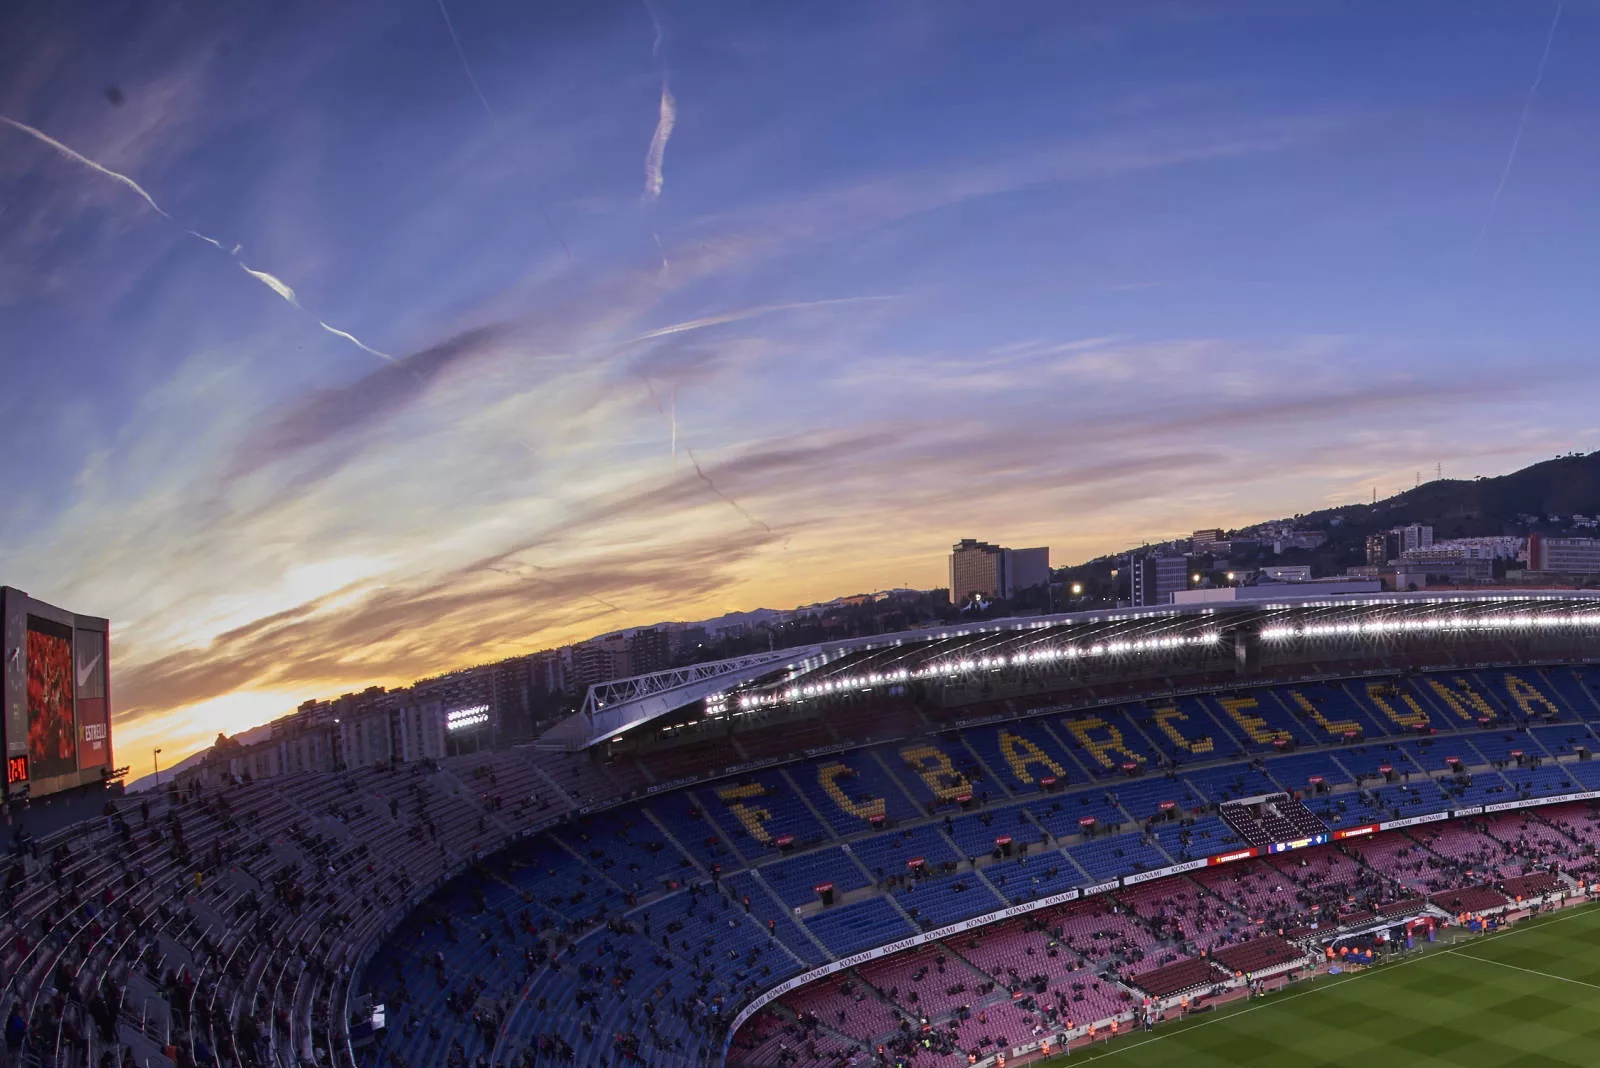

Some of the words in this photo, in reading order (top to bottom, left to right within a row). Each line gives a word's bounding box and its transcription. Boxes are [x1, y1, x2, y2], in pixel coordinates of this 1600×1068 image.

[799, 966, 830, 983] KONAMI
[839, 952, 871, 968] KONAMI
[882, 939, 914, 954] KONAMI
[924, 926, 956, 941] KONAMI
[966, 914, 997, 928] KONAMI
[1005, 903, 1035, 916] KONAMI
[1045, 892, 1075, 905] KONAMI
[1087, 883, 1117, 895] KONAMI
[1134, 871, 1162, 882] KONAMI
[1171, 862, 1198, 873] KONAMI
